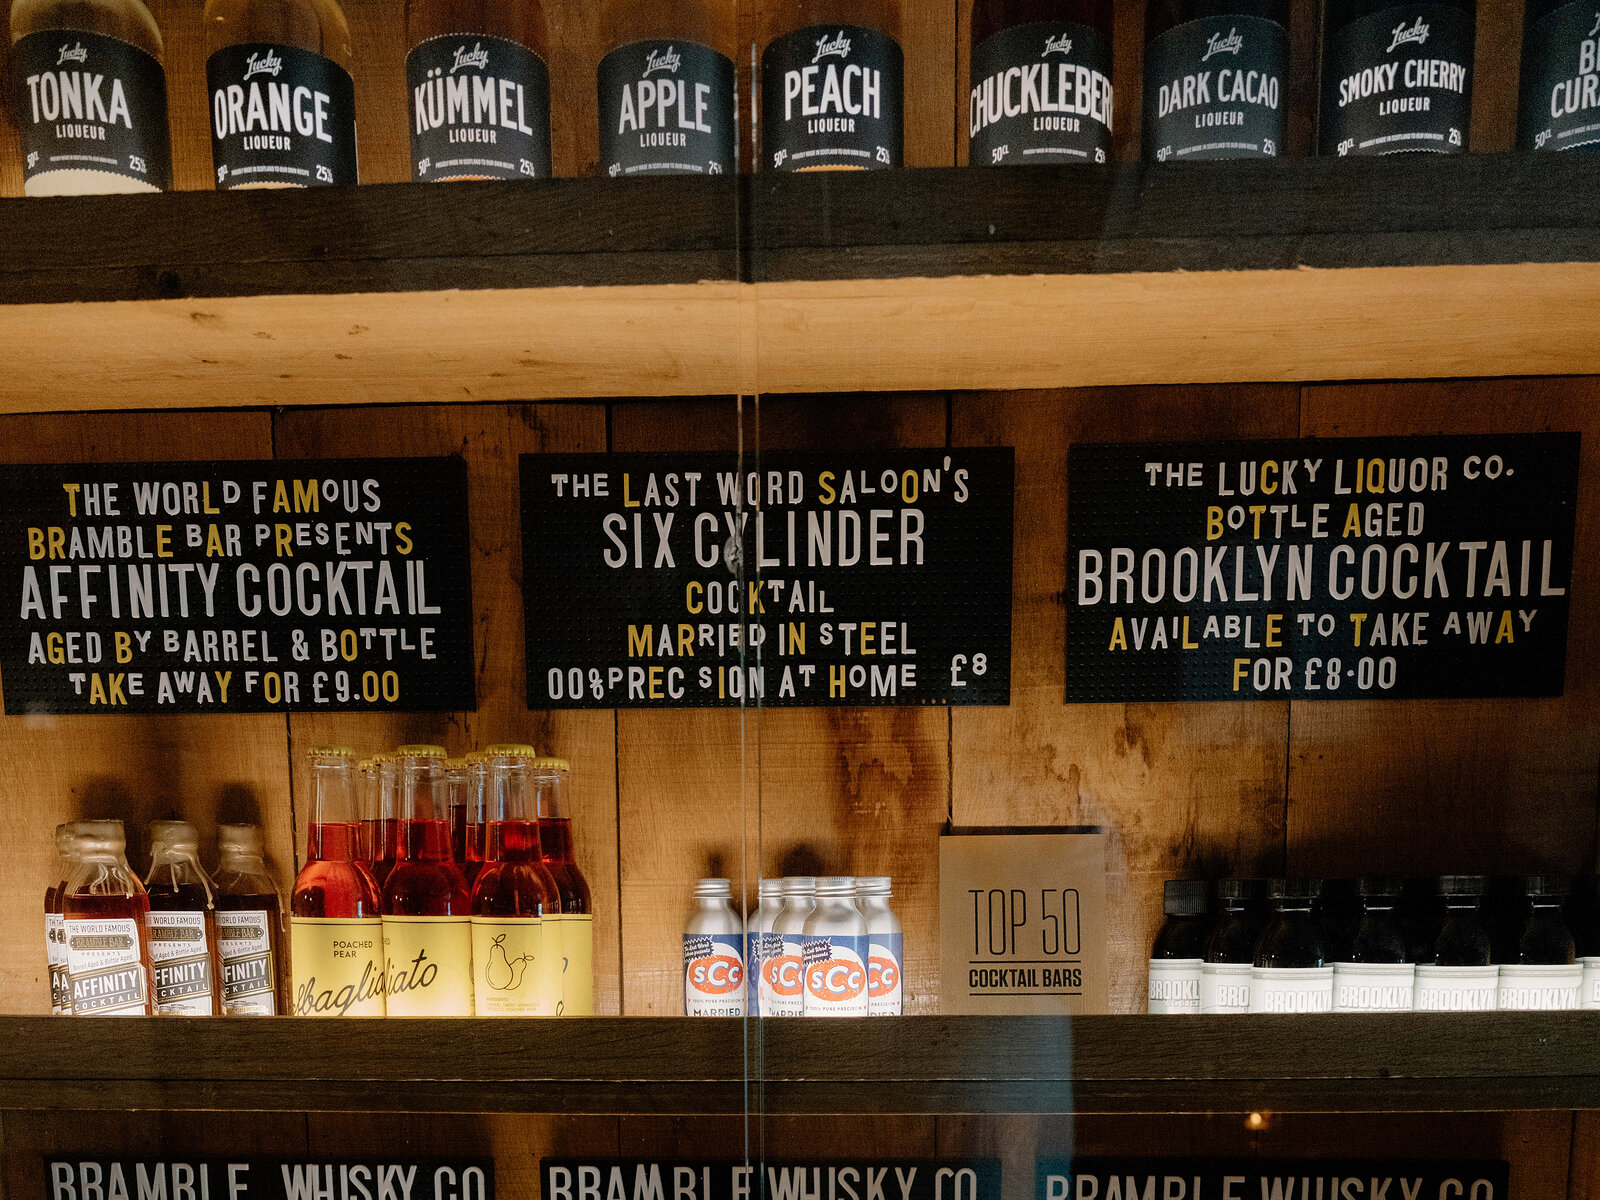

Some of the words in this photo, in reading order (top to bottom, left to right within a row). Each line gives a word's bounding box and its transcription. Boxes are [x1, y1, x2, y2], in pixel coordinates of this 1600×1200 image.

[811, 30, 852, 64] Lucky
[1041, 33, 1073, 58] Lucky
[1201, 21, 1243, 62] Lucky
[1386, 15, 1430, 53] Lucky
[56, 41, 88, 66] Lucky
[243, 49, 282, 81] Lucky
[450, 41, 489, 74] Lucky
[642, 46, 681, 78] Lucky
[26, 70, 132, 129] TONKA
[785, 64, 880, 121] PEACH
[1158, 71, 1210, 119] DARK
[1217, 69, 1279, 111] CACAO
[1339, 62, 1399, 108] SMOKY
[1404, 59, 1466, 94] CHERRY
[214, 82, 332, 143] ORANGE
[414, 67, 533, 136] KÜMMEL
[619, 79, 712, 134] APPLE
[1379, 97, 1430, 116] LIQUEUR
[56, 123, 106, 141] LIQUEUR
[449, 128, 497, 144] LIQUEUR
[808, 117, 855, 134] LIQUEUR
[1033, 117, 1081, 133] LIQUEUR
[1195, 111, 1244, 129] LIQUEUR
[243, 135, 291, 151] LIQUEUR
[640, 132, 687, 147] LIQUEUR
[551, 473, 609, 497] THE
[623, 472, 701, 508] LAST
[717, 472, 803, 506] WORD
[818, 456, 969, 504] SALOON'S
[1145, 462, 1203, 487] THE
[1218, 458, 1323, 497] LUCKY
[1335, 457, 1448, 495] LIQUOR
[1463, 454, 1515, 480] CO.
[63, 482, 120, 517] THE
[133, 480, 241, 515] WORLD
[253, 478, 381, 514] FAMOUS
[603, 512, 675, 569] SIX
[695, 508, 925, 567] CYLINDER
[1206, 503, 1329, 540] BOTTLE
[1342, 502, 1425, 538] AGED
[28, 525, 173, 560] BRAMBLE
[185, 524, 242, 558] BAR
[256, 521, 413, 557] PRESENTS
[20, 563, 219, 619] AFFINITY
[236, 560, 441, 617] COCKTAIL
[1078, 544, 1314, 606] BROOKLYN
[1329, 539, 1566, 600] COCKTAIL
[686, 580, 835, 614] COCKTAIL
[29, 631, 101, 664] AGED
[115, 630, 151, 663] BY
[164, 629, 278, 662] BARREL
[292, 629, 309, 660] &
[321, 627, 436, 660] BOTTLE
[628, 624, 766, 658] MARRIED
[778, 623, 806, 656] IN
[820, 622, 916, 656] STEEL
[1109, 613, 1283, 651] AVAILABLE
[1297, 613, 1336, 638] TO
[1349, 611, 1429, 647] TAKE
[1442, 609, 1538, 645] AWAY
[69, 672, 145, 705] TAKE
[157, 671, 231, 703] AWAY
[245, 671, 299, 702] FOR
[313, 669, 399, 702] £9.00
[779, 664, 816, 699] AT
[829, 664, 917, 699] HOME
[950, 653, 987, 687] £8
[1233, 657, 1292, 692] FOR
[69, 925, 79, 933] THE
[81, 925, 103, 933] WORLD
[104, 924, 131, 933] FAMOUS
[153, 916, 175, 925] WORLD
[176, 916, 201, 925] FAMOUS
[968, 889, 1026, 955] TOP
[1042, 888, 1081, 955] 50
[333, 940, 373, 949] POACHED
[333, 950, 357, 958] PEAR
[74, 969, 138, 1000] AFFINITY
[969, 969, 1039, 988] COCKTAIL
[1043, 968, 1082, 987] BARS
[74, 992, 140, 1011] COCKTAIL
